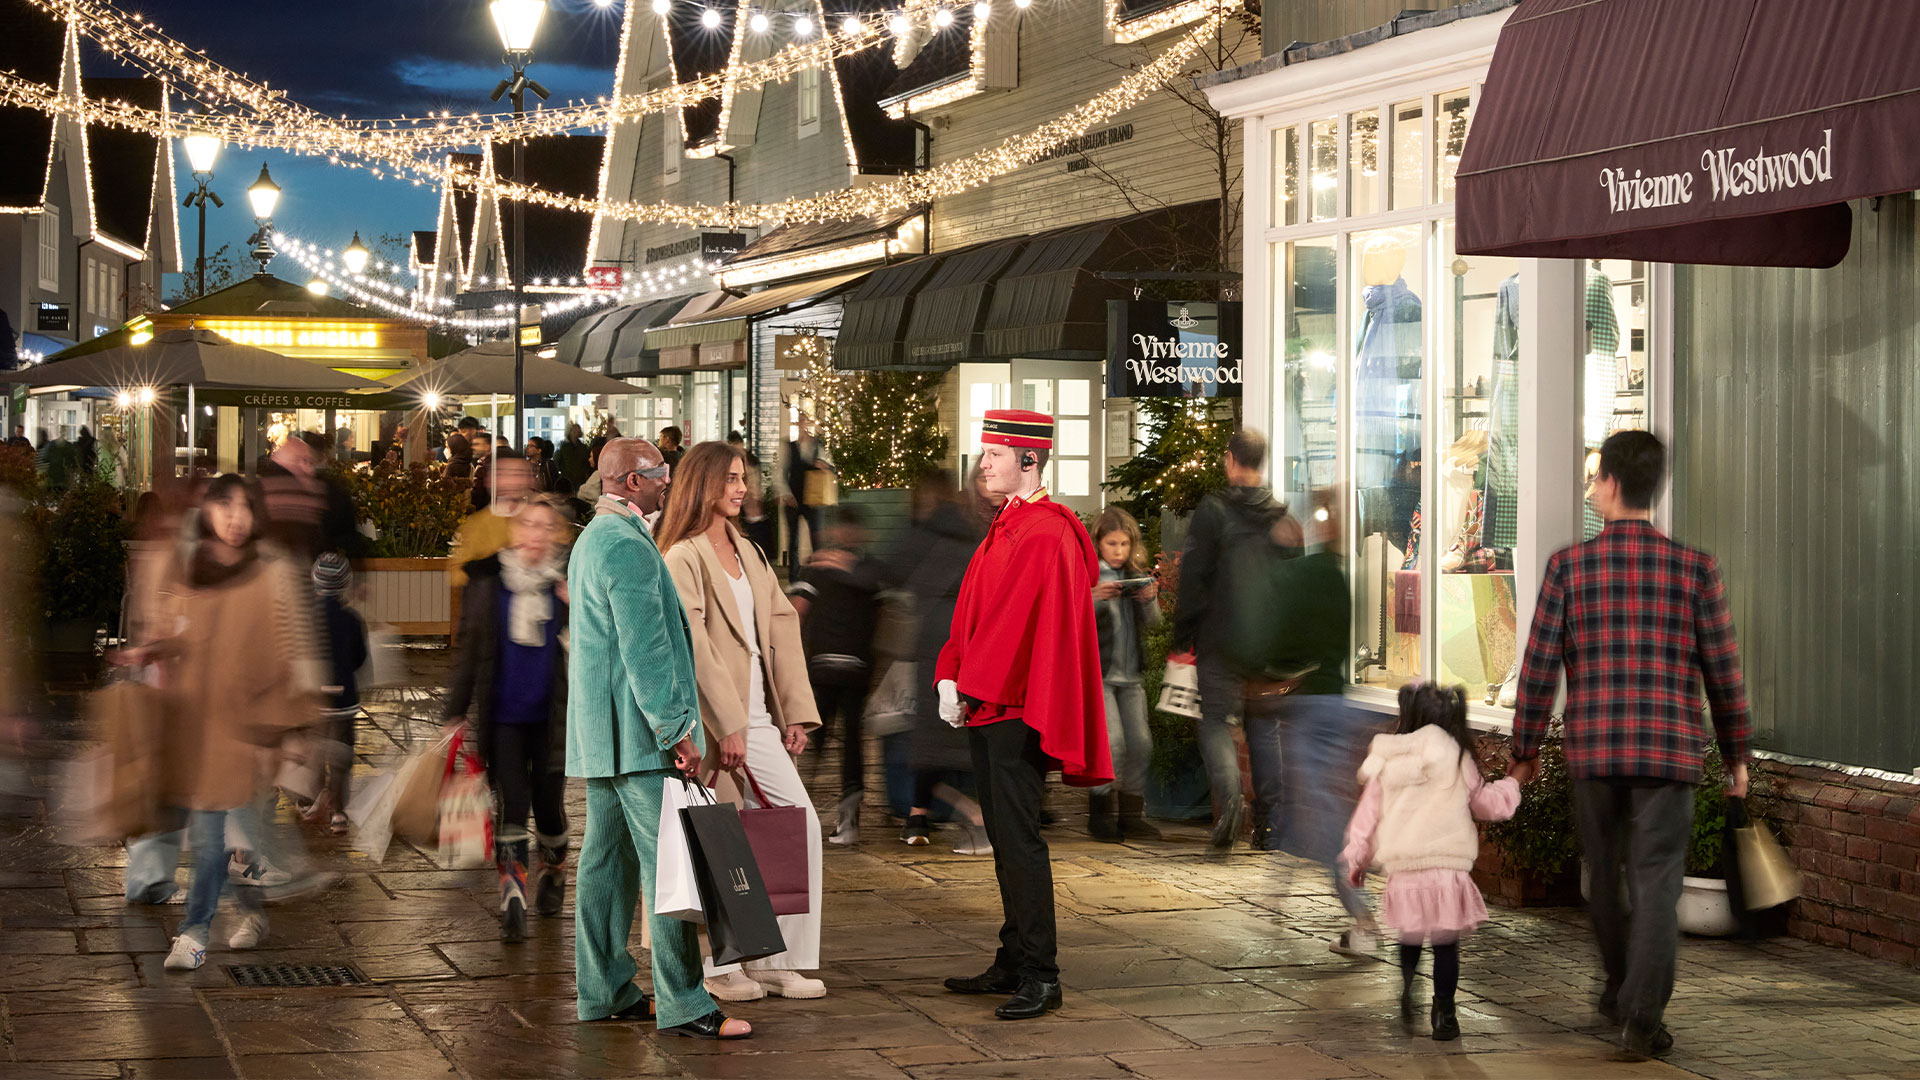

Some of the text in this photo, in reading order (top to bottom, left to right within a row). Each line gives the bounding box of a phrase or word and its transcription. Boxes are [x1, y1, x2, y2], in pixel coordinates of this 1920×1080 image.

[1055, 138, 1079, 158] GOOSE
[1080, 131, 1107, 152] DELUXE
[1108, 123, 1133, 145] BRAND
[1600, 129, 1832, 214] Vivienne Westwood
[705, 246, 720, 254] Paul
[217, 329, 292, 346] EPERIE
[1125, 333, 1243, 386] Vivienne Westwood
[244, 393, 352, 407] CRÊPES & COFFEE
